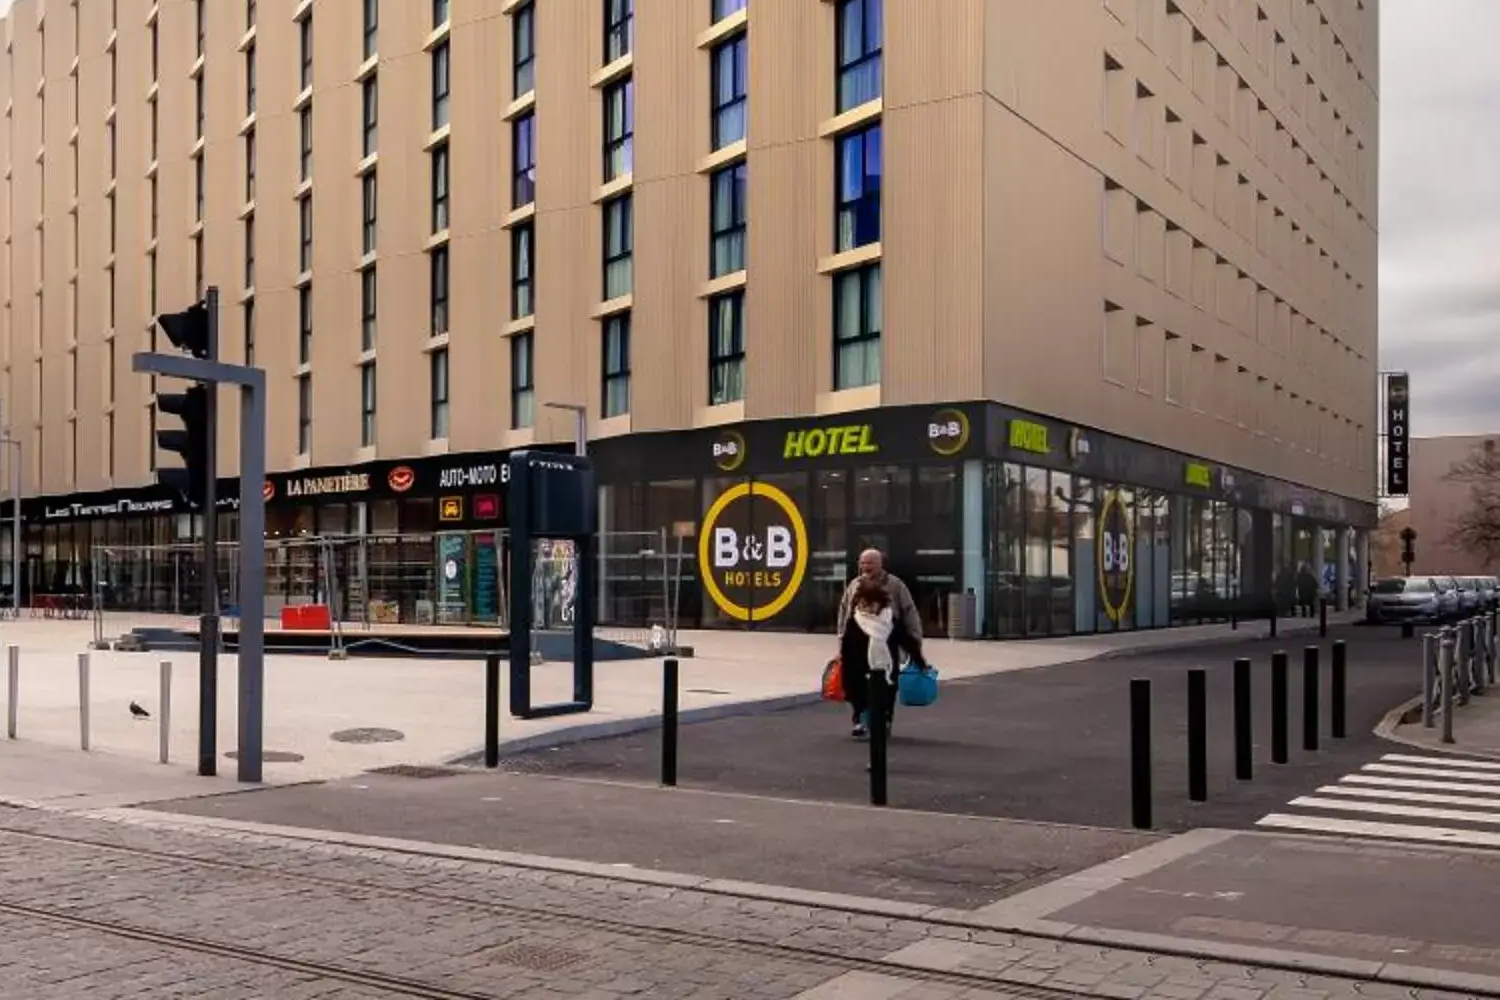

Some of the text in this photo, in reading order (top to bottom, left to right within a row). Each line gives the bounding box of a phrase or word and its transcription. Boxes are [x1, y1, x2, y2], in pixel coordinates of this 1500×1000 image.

[784, 424, 878, 458] HOTEL
[1392, 408, 1404, 485] HOTEL
[286, 479, 302, 497] LA
[439, 464, 497, 488] AUTO-MOTO
[715, 526, 793, 567] B&B
